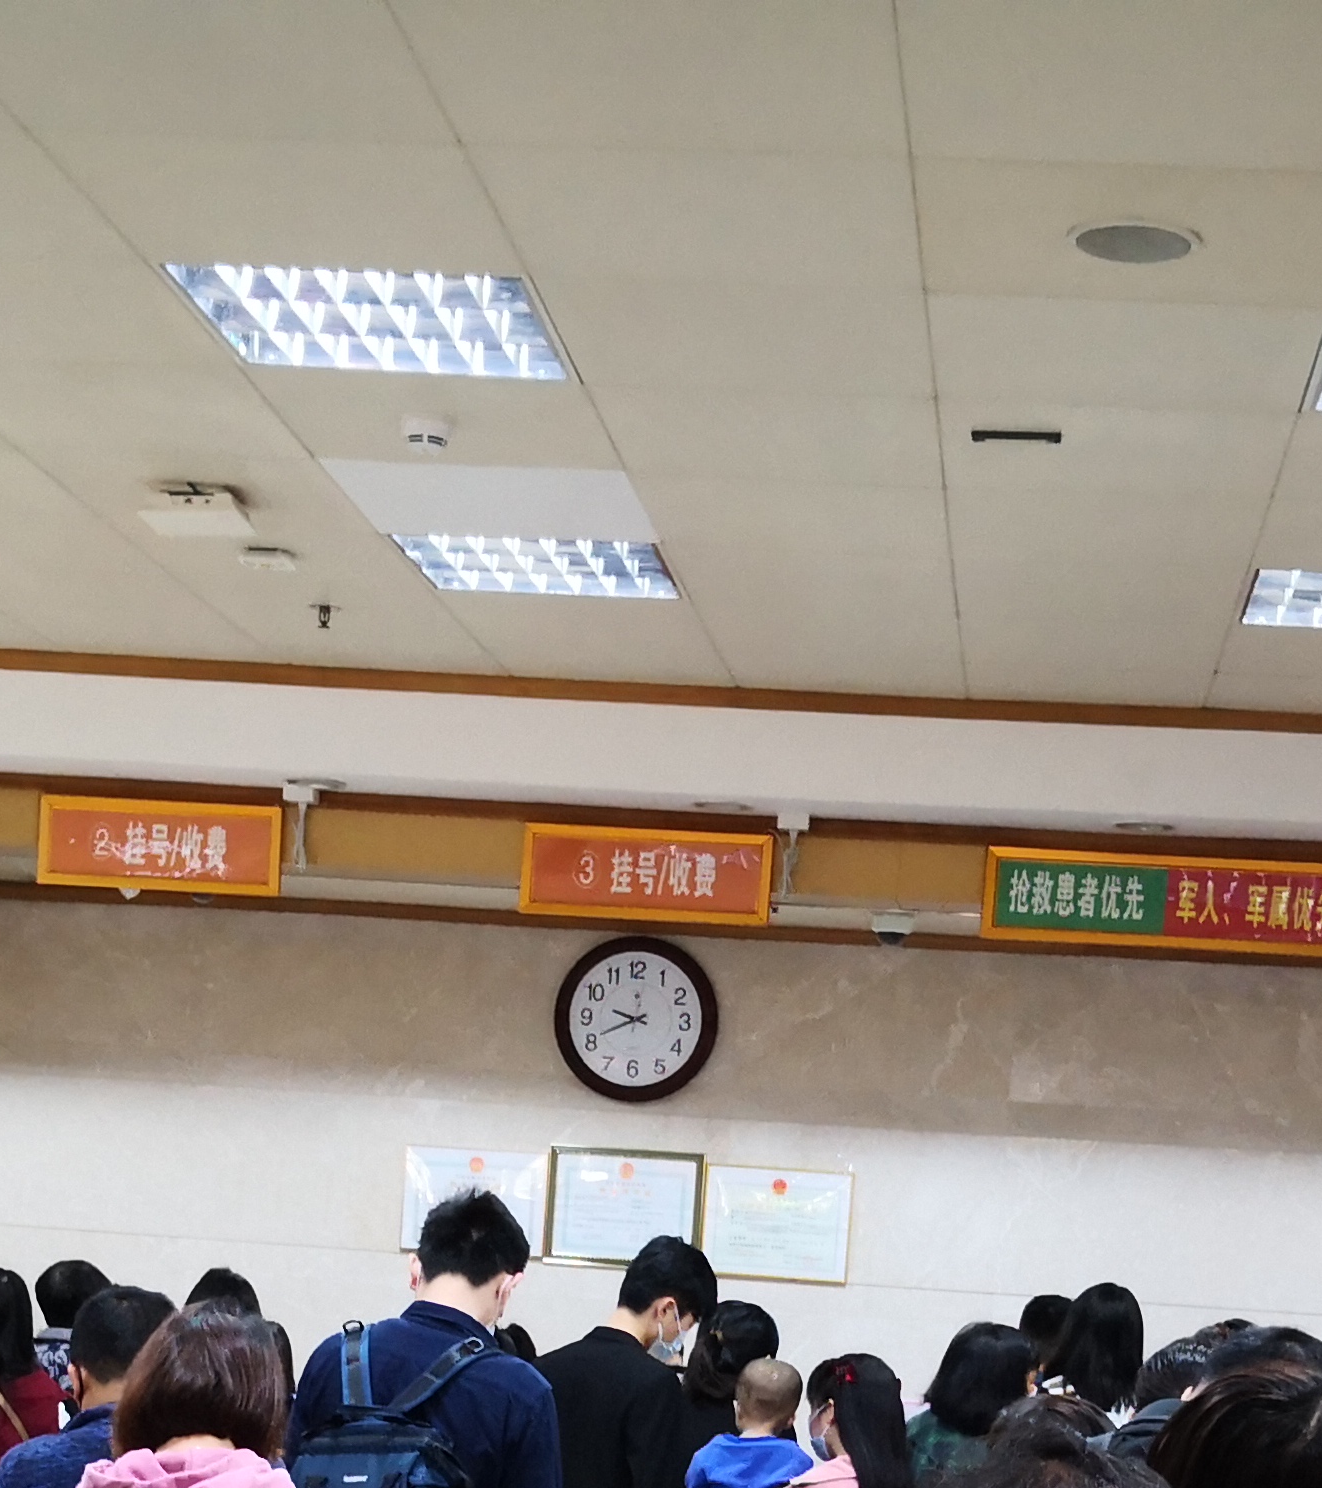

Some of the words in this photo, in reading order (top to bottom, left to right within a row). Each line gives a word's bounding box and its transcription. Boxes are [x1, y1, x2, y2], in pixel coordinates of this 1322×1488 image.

[125, 819, 227, 875] 挂号/收费
[609, 848, 717, 898] 挂号/收费
[1008, 868, 1145, 921] 抢救患者优先
[607, 966, 620, 985] 11
[629, 960, 647, 980] 12
[659, 969, 666, 987] 1
[587, 983, 605, 1001] 10
[674, 987, 687, 1006] 2
[580, 1007, 593, 1026] 9
[678, 1012, 691, 1031] 3
[585, 1033, 598, 1051] 8
[669, 1038, 682, 1056] 4
[603, 1056, 615, 1071] 7
[627, 1059, 639, 1078] 6
[653, 1058, 666, 1074] 5
